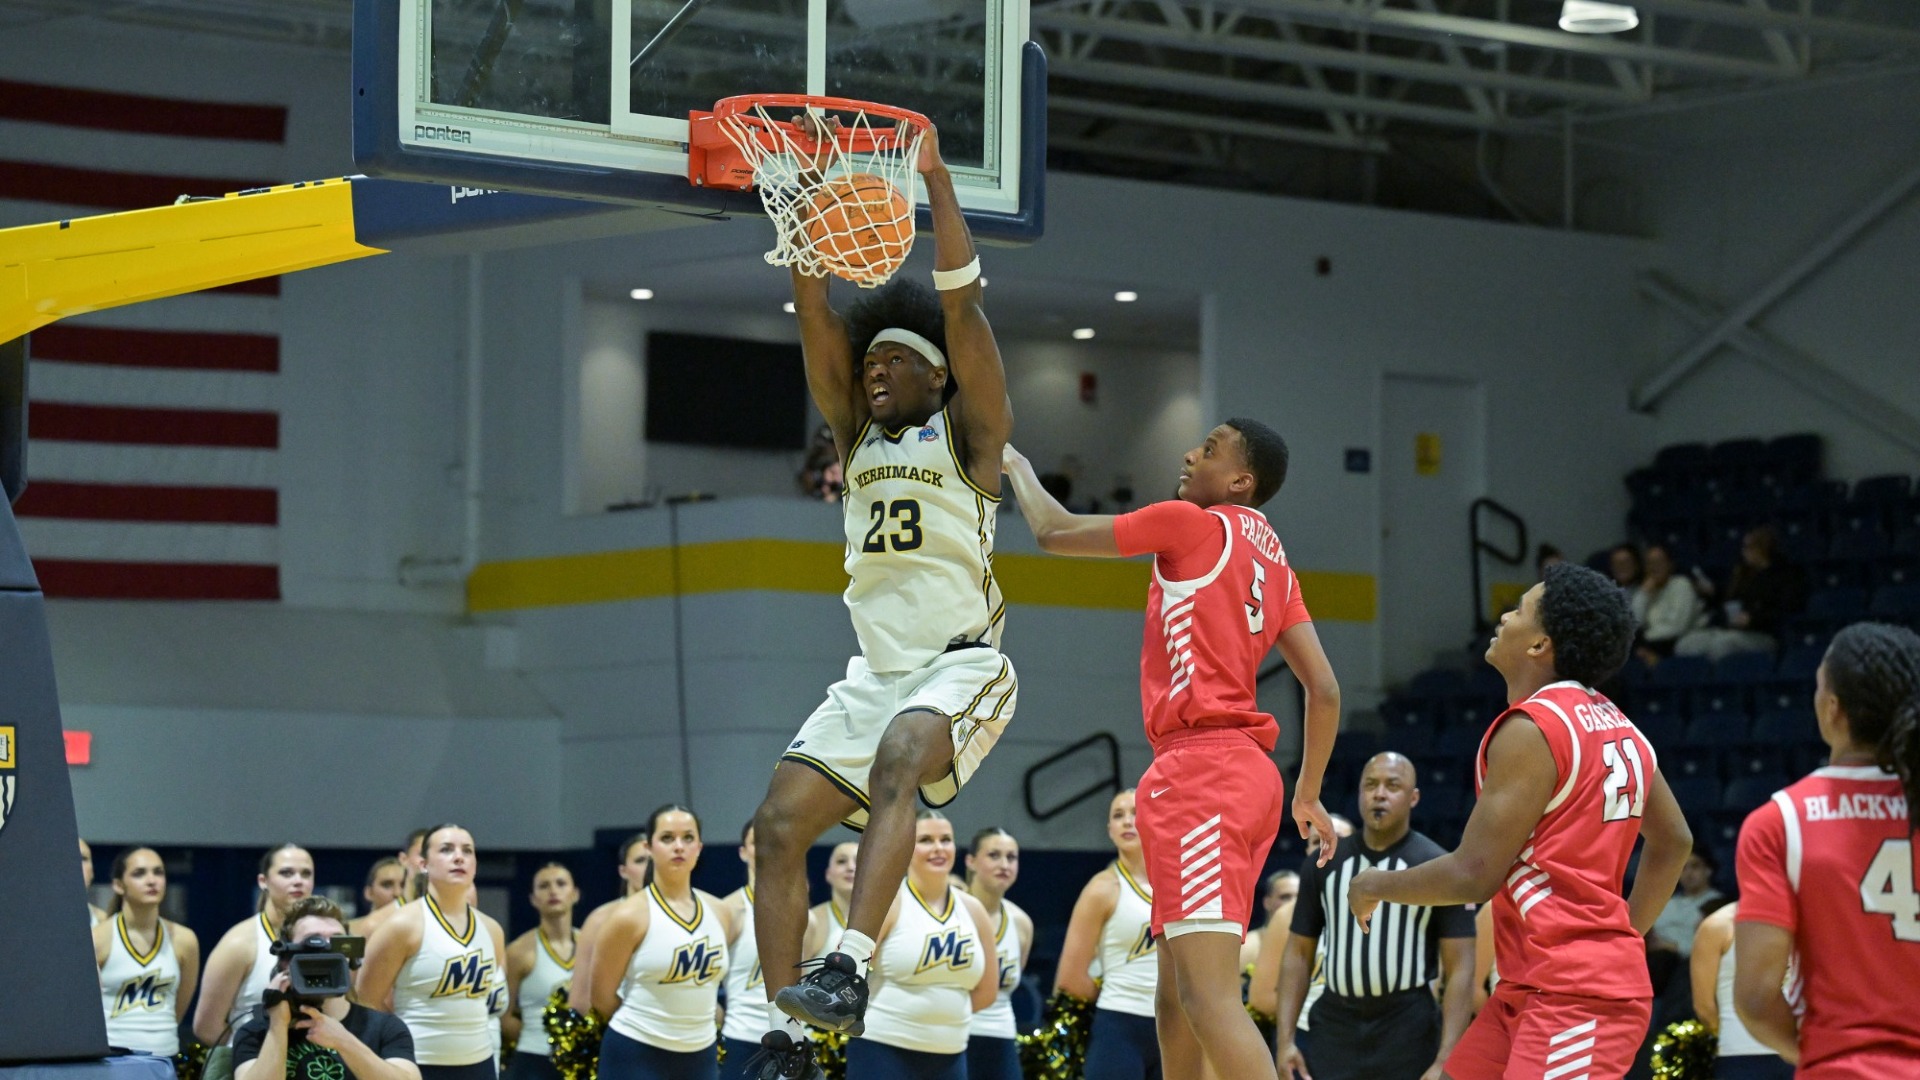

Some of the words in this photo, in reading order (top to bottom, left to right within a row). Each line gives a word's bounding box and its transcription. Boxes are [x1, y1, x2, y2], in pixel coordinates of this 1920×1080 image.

[854, 465, 944, 489] MERRIMACK
[862, 498, 923, 553] 23
[1244, 556, 1266, 636] 5
[1602, 736, 1645, 824] 21
[1859, 837, 1920, 942] 4
[429, 948, 495, 999] MC
[658, 936, 723, 986] MC
[913, 926, 974, 975] MC
[109, 968, 176, 1019] MC
